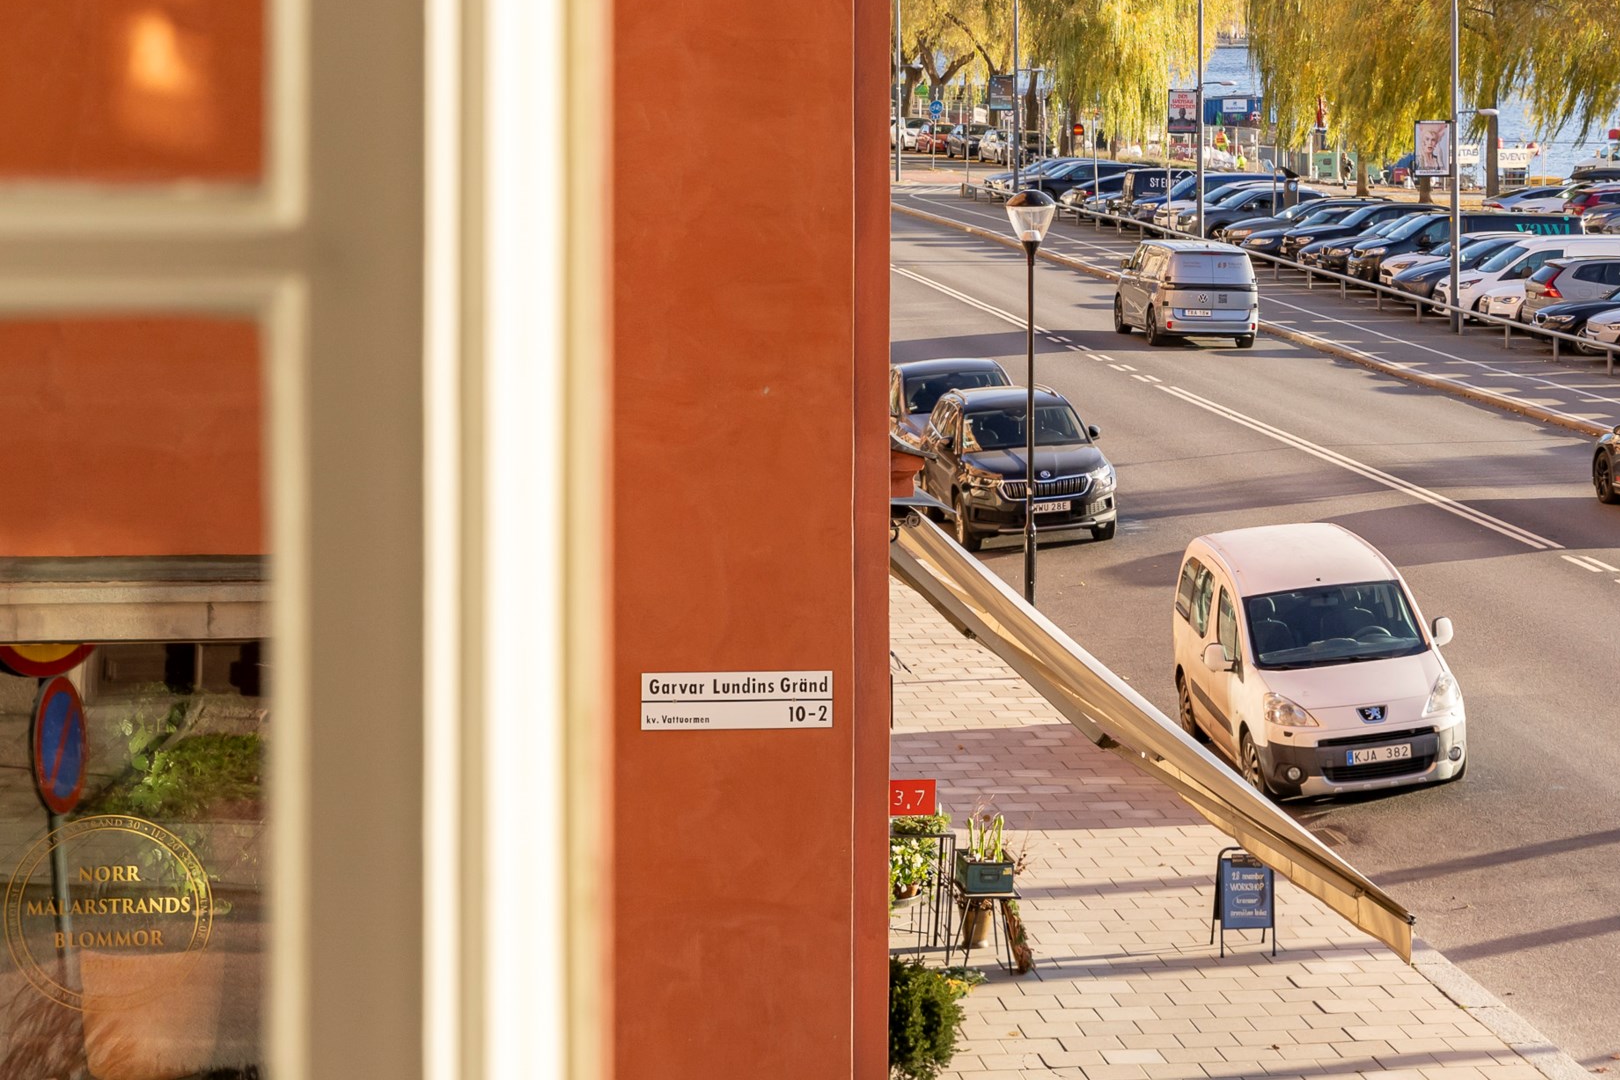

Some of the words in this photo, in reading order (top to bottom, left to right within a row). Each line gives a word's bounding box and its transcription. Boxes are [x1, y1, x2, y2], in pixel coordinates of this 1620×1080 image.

[1051, 502, 1067, 510] 28E
[650, 679, 705, 695] Garvar
[713, 677, 775, 694] Lundins
[780, 676, 828, 693] Gränd
[646, 715, 659, 724] kv.
[662, 715, 710, 724] Vattuormen
[1354, 750, 1378, 763] KJA
[1386, 746, 1409, 759] 382
[79, 865, 141, 882] NORR
[1229, 882, 1265, 892] WORKSHOP
[27, 896, 191, 916] MÄLARSTRANDS
[55, 930, 163, 949] BLOMMOR
